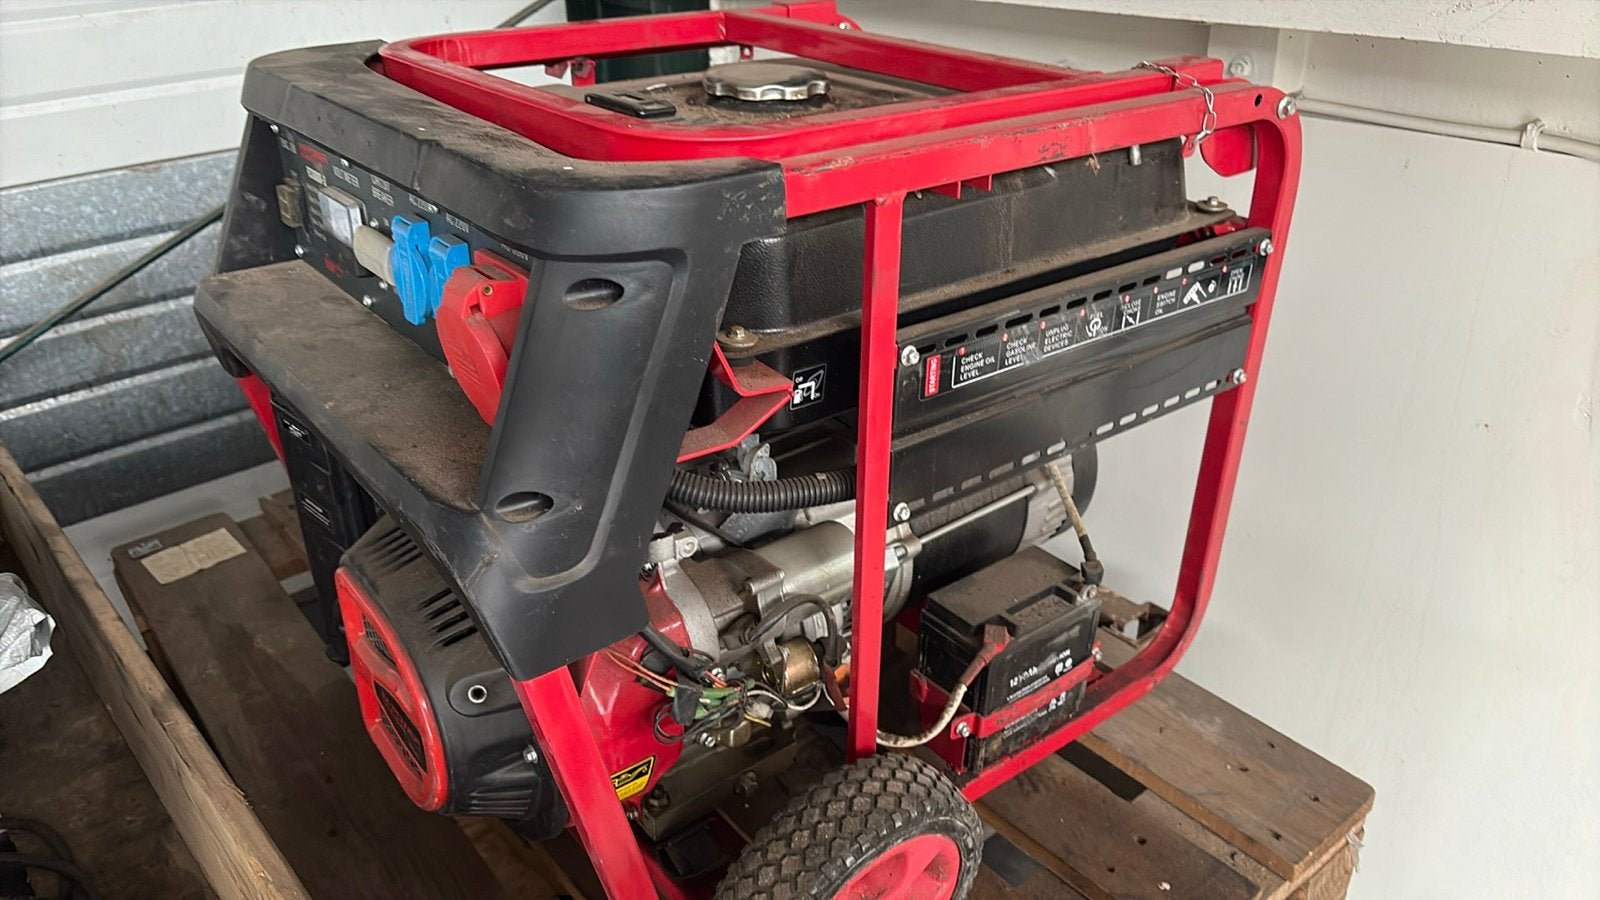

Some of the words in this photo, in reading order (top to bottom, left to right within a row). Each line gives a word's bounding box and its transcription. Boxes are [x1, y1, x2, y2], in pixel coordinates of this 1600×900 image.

[1006, 337, 1028, 350] CHECK
[1044, 330, 1073, 345] ELECTRIC
[960, 360, 985, 374] ENGINE
[985, 356, 995, 365] OIL
[961, 352, 983, 365] CHECK
[960, 369, 980, 381] LEVEL
